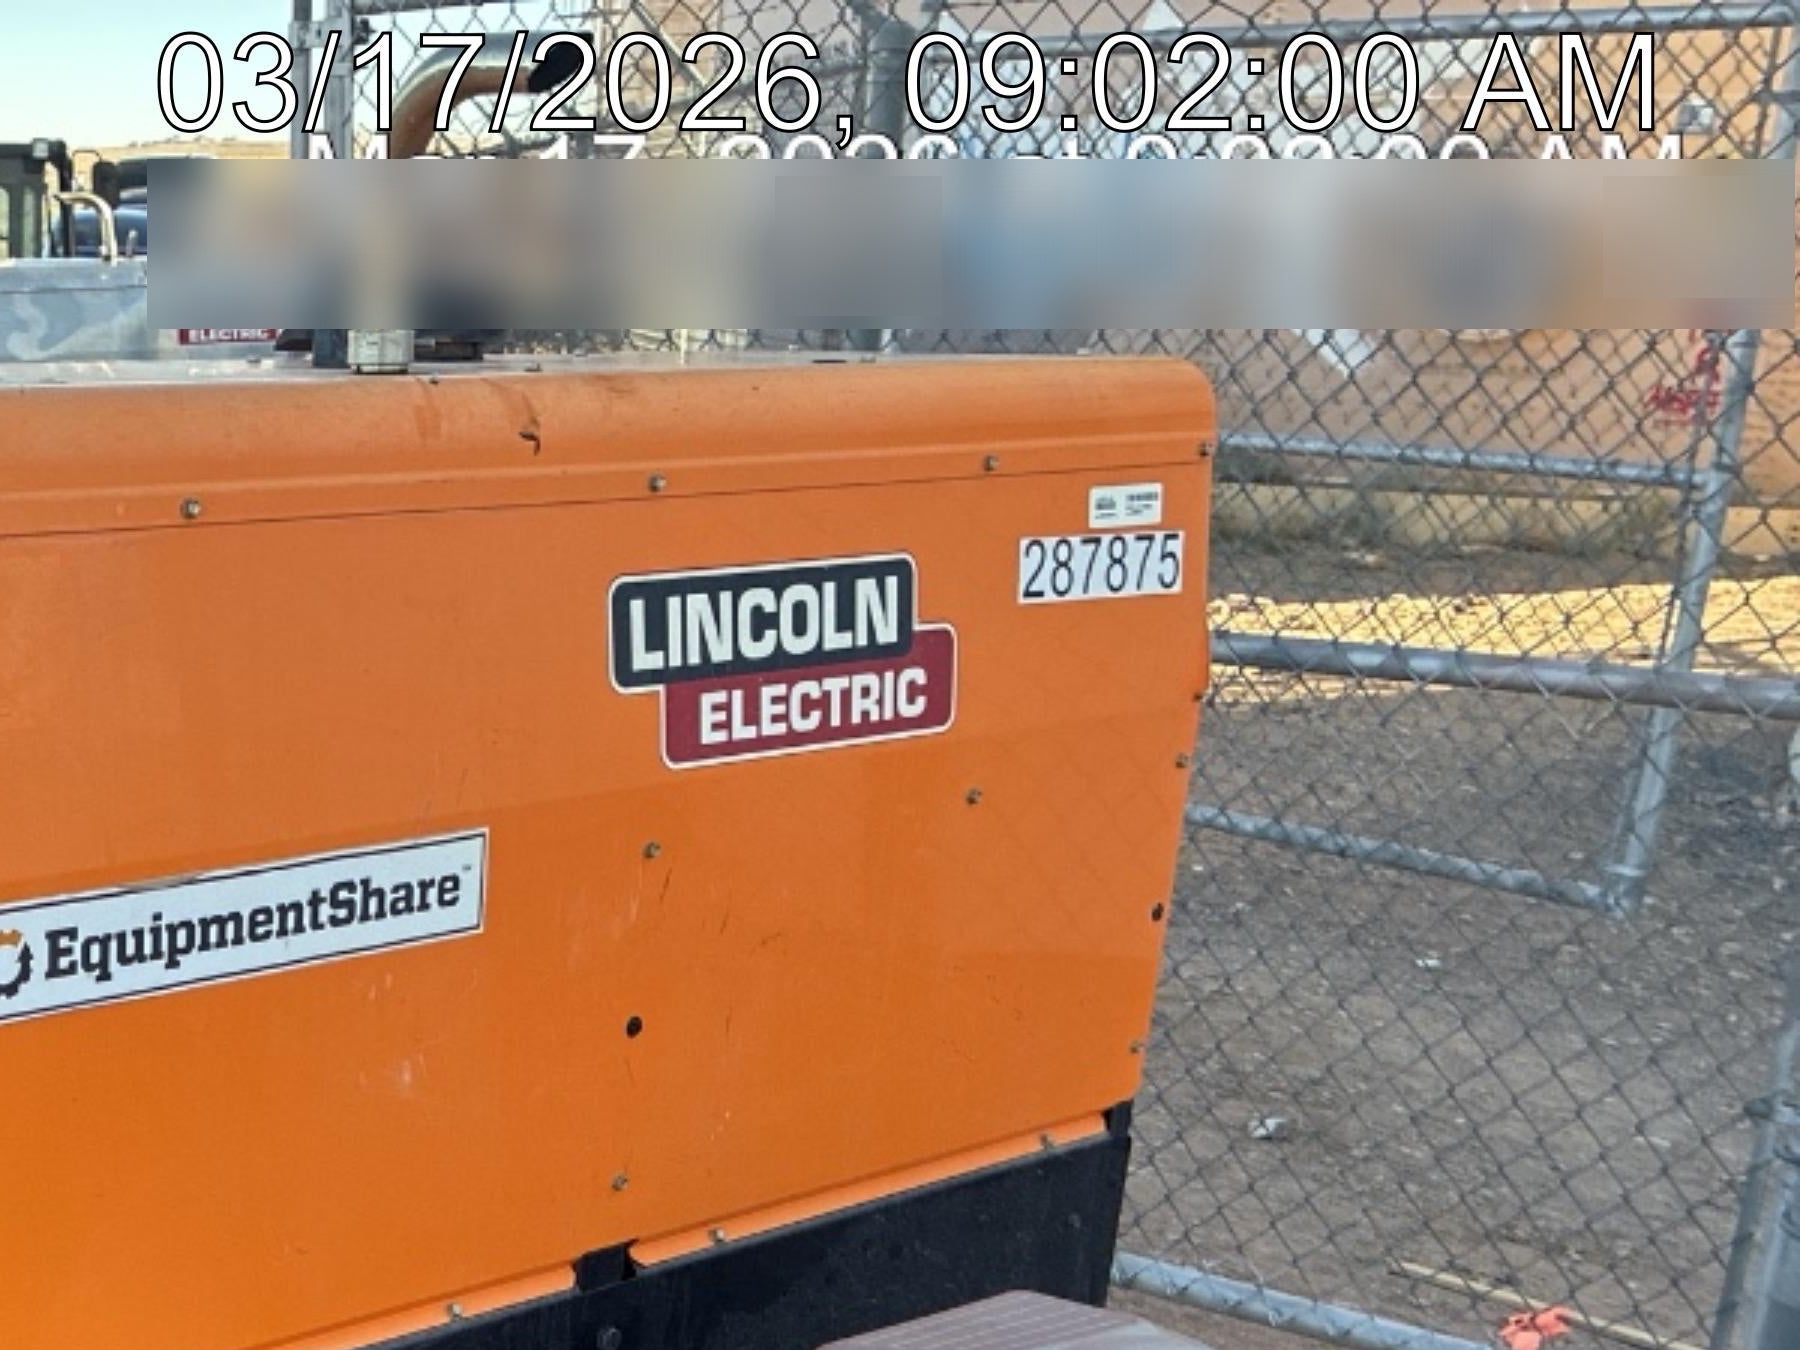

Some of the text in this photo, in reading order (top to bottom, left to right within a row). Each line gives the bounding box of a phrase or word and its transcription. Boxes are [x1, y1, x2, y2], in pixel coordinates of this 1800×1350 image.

[1022, 533, 1180, 598] 287875
[629, 575, 899, 673] LINCOLN
[700, 667, 928, 746] ELECTRIC
[44, 872, 461, 982] EquipmentShare
